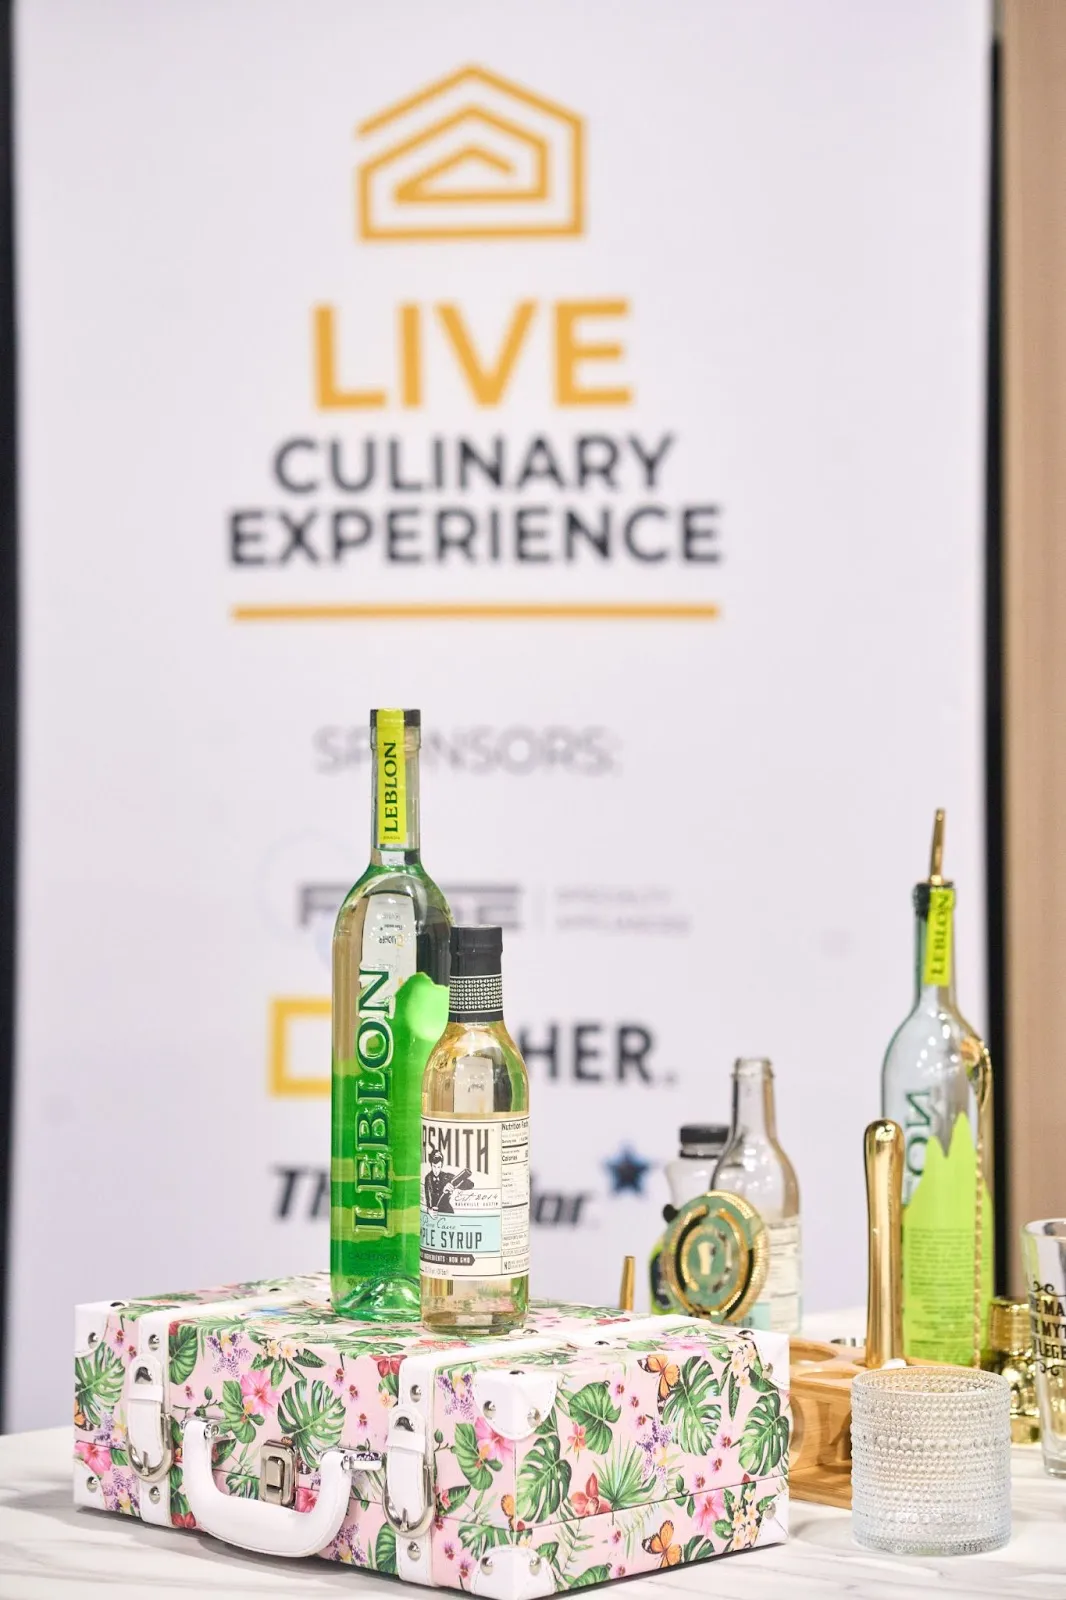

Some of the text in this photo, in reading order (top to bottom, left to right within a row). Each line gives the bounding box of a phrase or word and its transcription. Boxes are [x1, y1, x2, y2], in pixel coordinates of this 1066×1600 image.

[312, 298, 635, 411] LIVE
[272, 430, 676, 497] CULINARY
[226, 503, 724, 569] EXPERIENCE
[384, 741, 398, 832] LEBLON
[931, 893, 951, 975] LEBLON
[354, 970, 392, 1233] LEBLON
[421, 1124, 489, 1176] RSMITH
[440, 1231, 482, 1250] SYRUP
